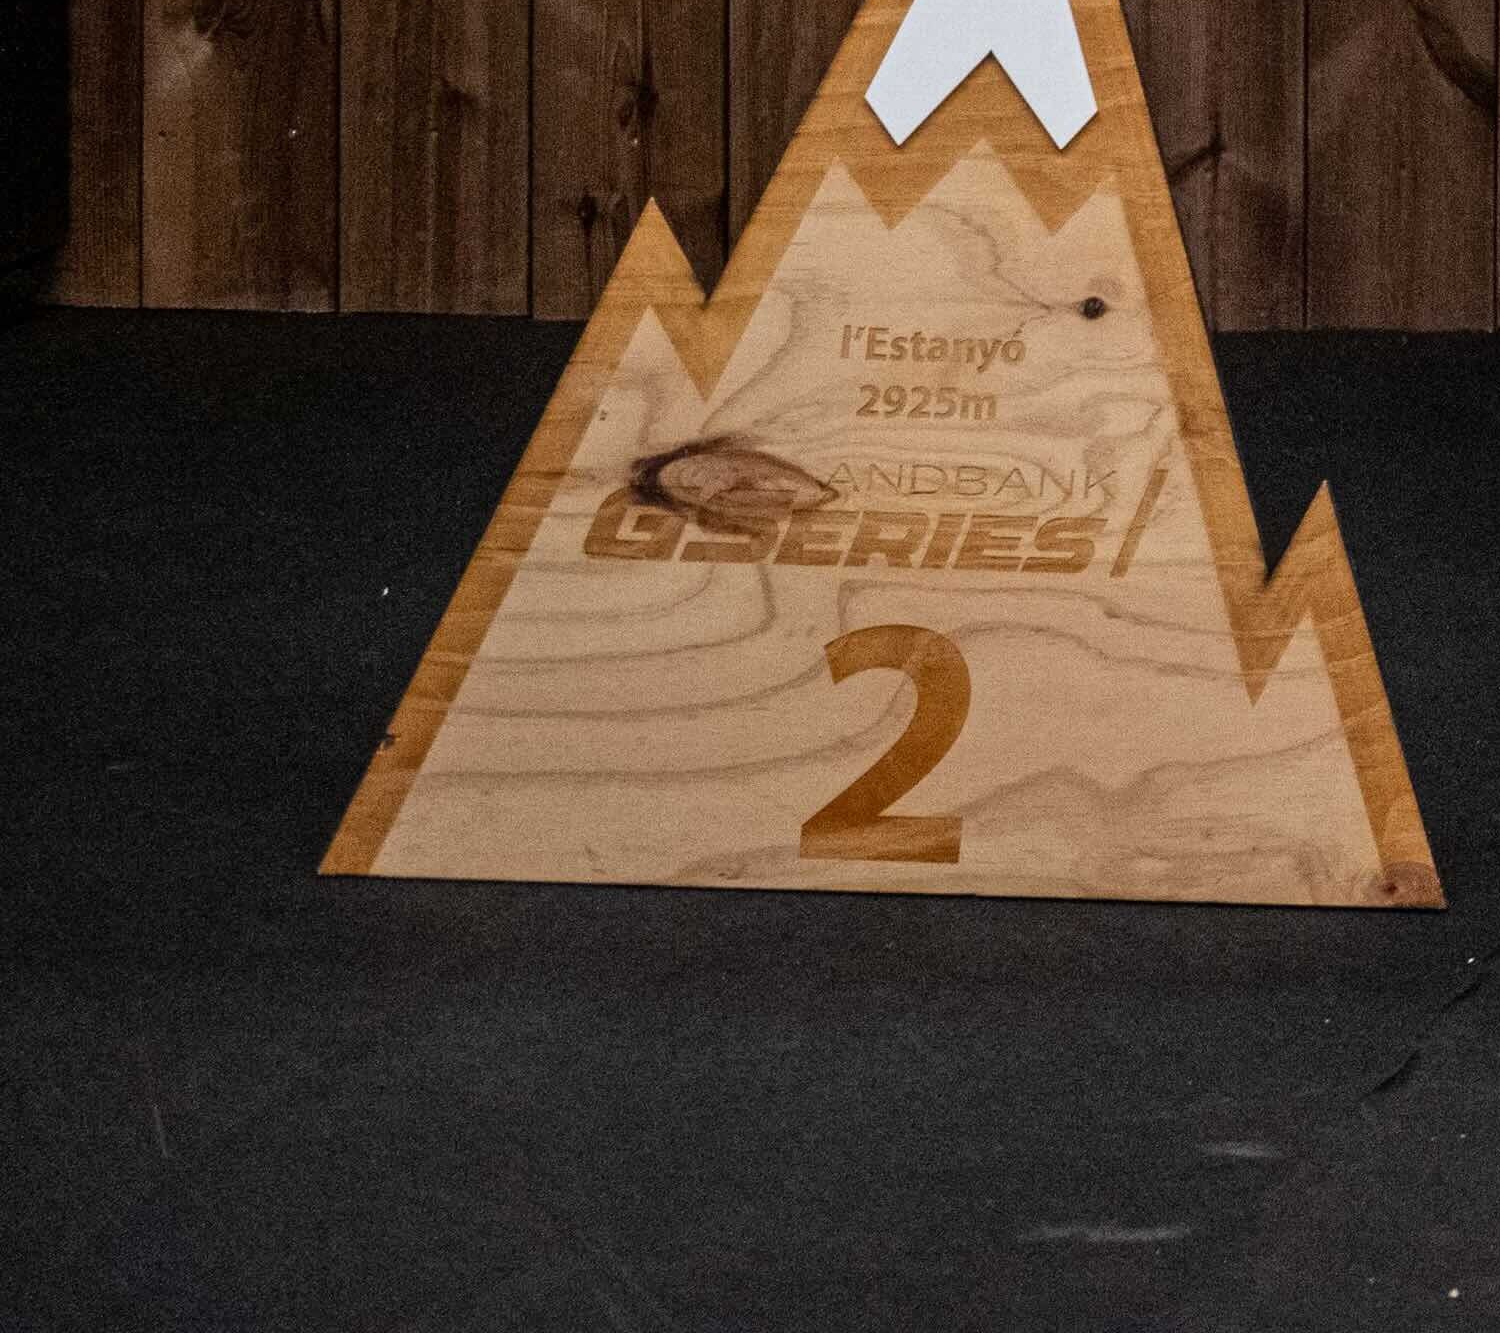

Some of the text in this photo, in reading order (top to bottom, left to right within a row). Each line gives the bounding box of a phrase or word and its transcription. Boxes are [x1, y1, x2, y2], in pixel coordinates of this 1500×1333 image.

[855, 384, 998, 422] 2925m
[828, 461, 1119, 503] ANDBANK
[583, 485, 1108, 575] GSERIES
[800, 623, 971, 864] 2
